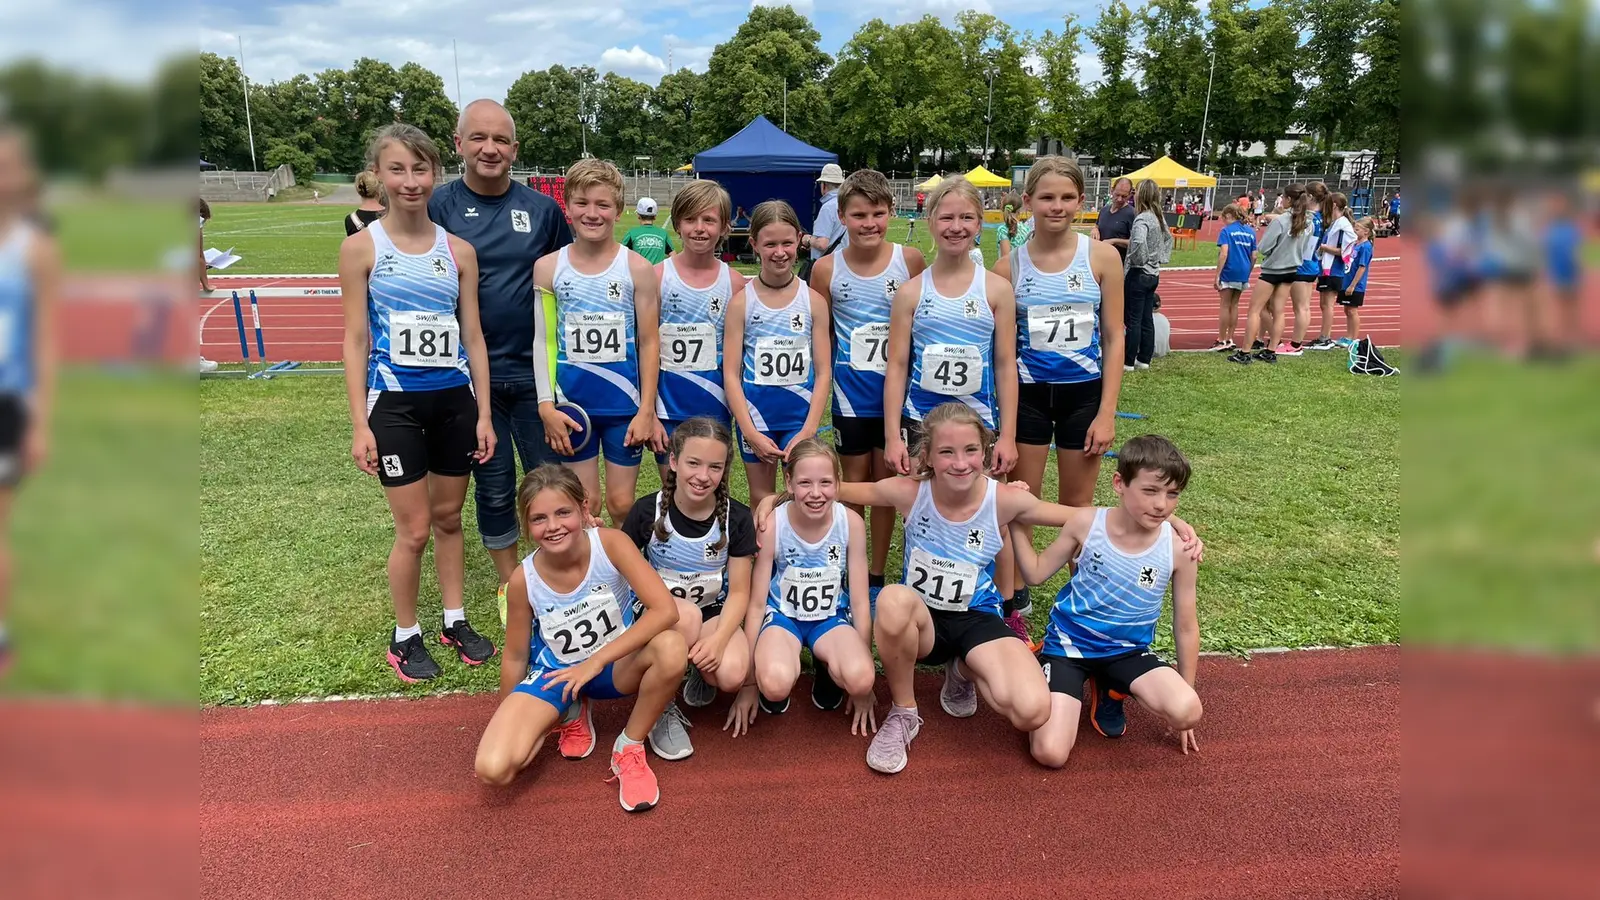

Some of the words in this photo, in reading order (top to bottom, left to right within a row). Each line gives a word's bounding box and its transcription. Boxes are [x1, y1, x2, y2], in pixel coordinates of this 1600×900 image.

[399, 328, 452, 357] 181
[572, 328, 621, 354] 194
[1044, 318, 1078, 343] 71
[672, 339, 703, 363] 97
[760, 352, 805, 377] 304
[934, 360, 968, 387] 43
[786, 584, 834, 612] 465
[912, 566, 963, 603] 211
[553, 609, 617, 654] 231
